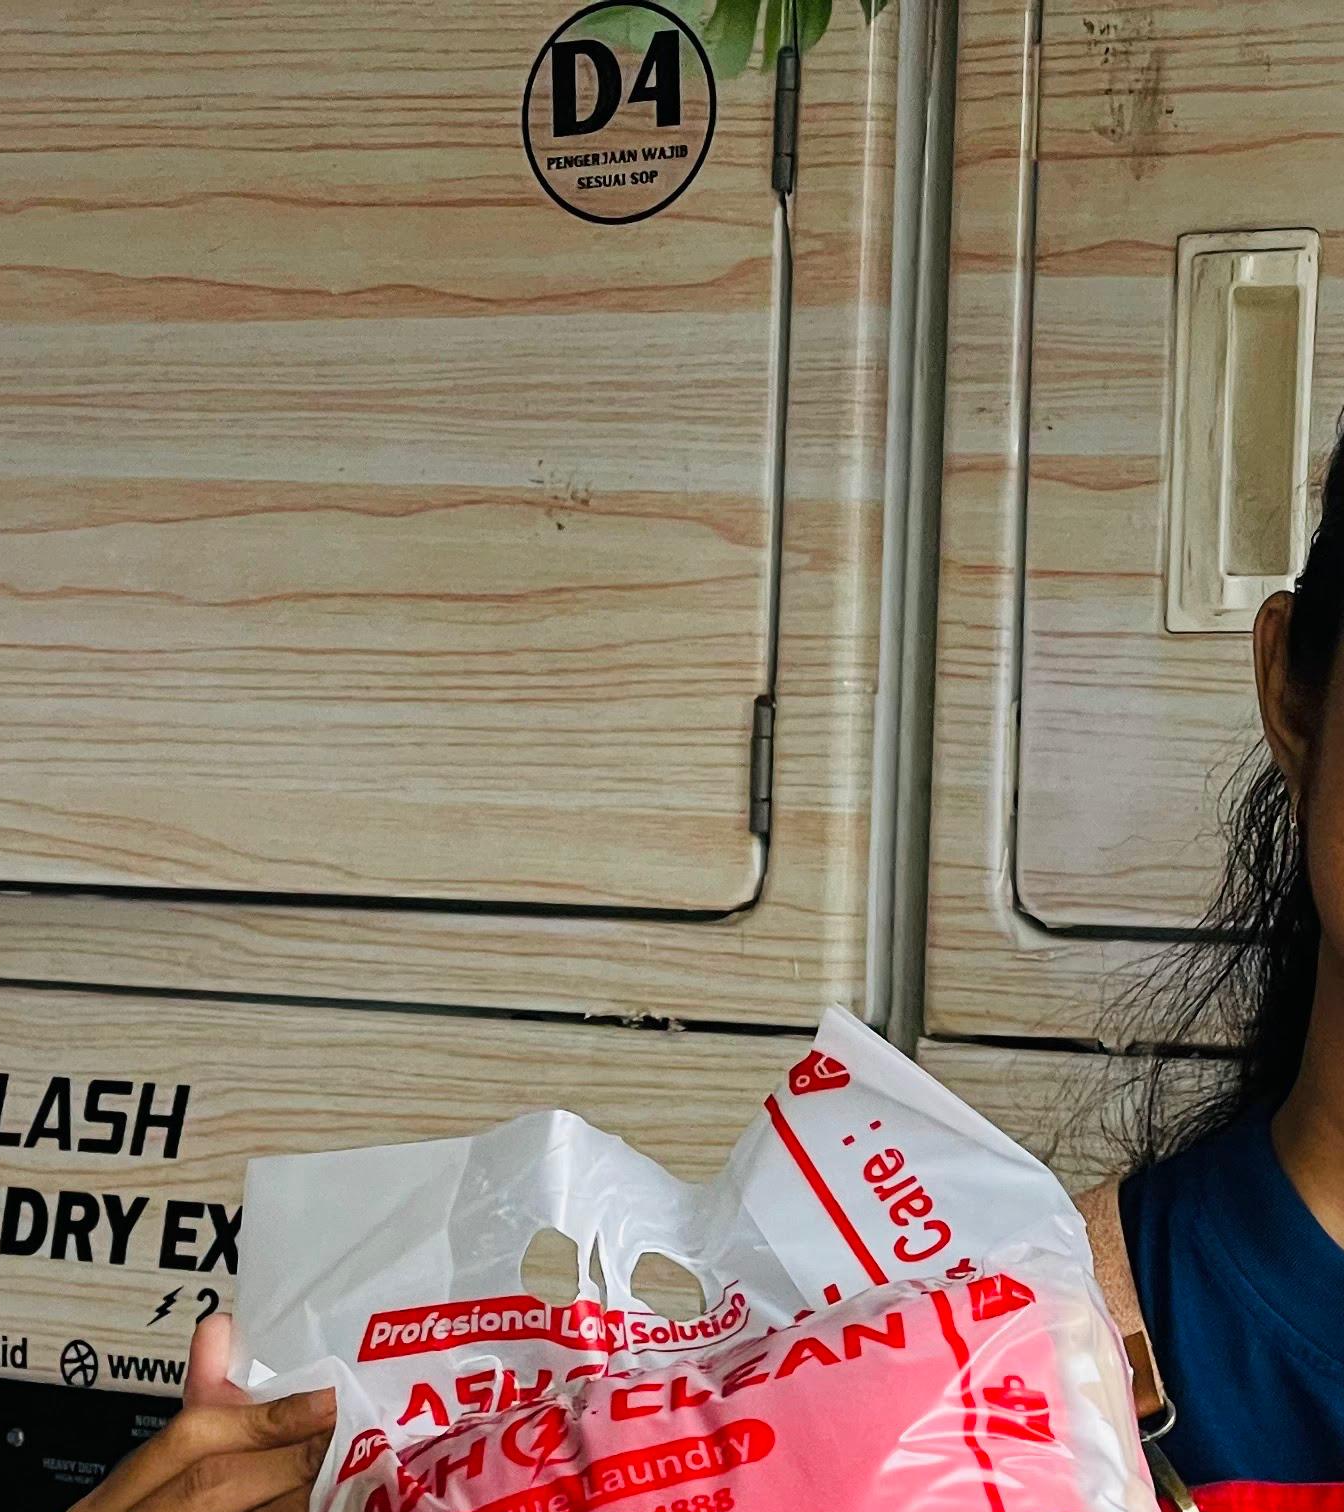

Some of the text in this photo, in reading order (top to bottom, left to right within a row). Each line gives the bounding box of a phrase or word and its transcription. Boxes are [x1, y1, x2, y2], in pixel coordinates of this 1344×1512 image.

[551, 29, 681, 138] D4
[547, 145, 688, 170] PENGERJAAN WAJIB
[577, 170, 659, 189] SESUAI SOP
[863, 1148, 952, 1263] Care
[370, 1306, 551, 1349] Profesional
[582, 1428, 753, 1499] Laundry
